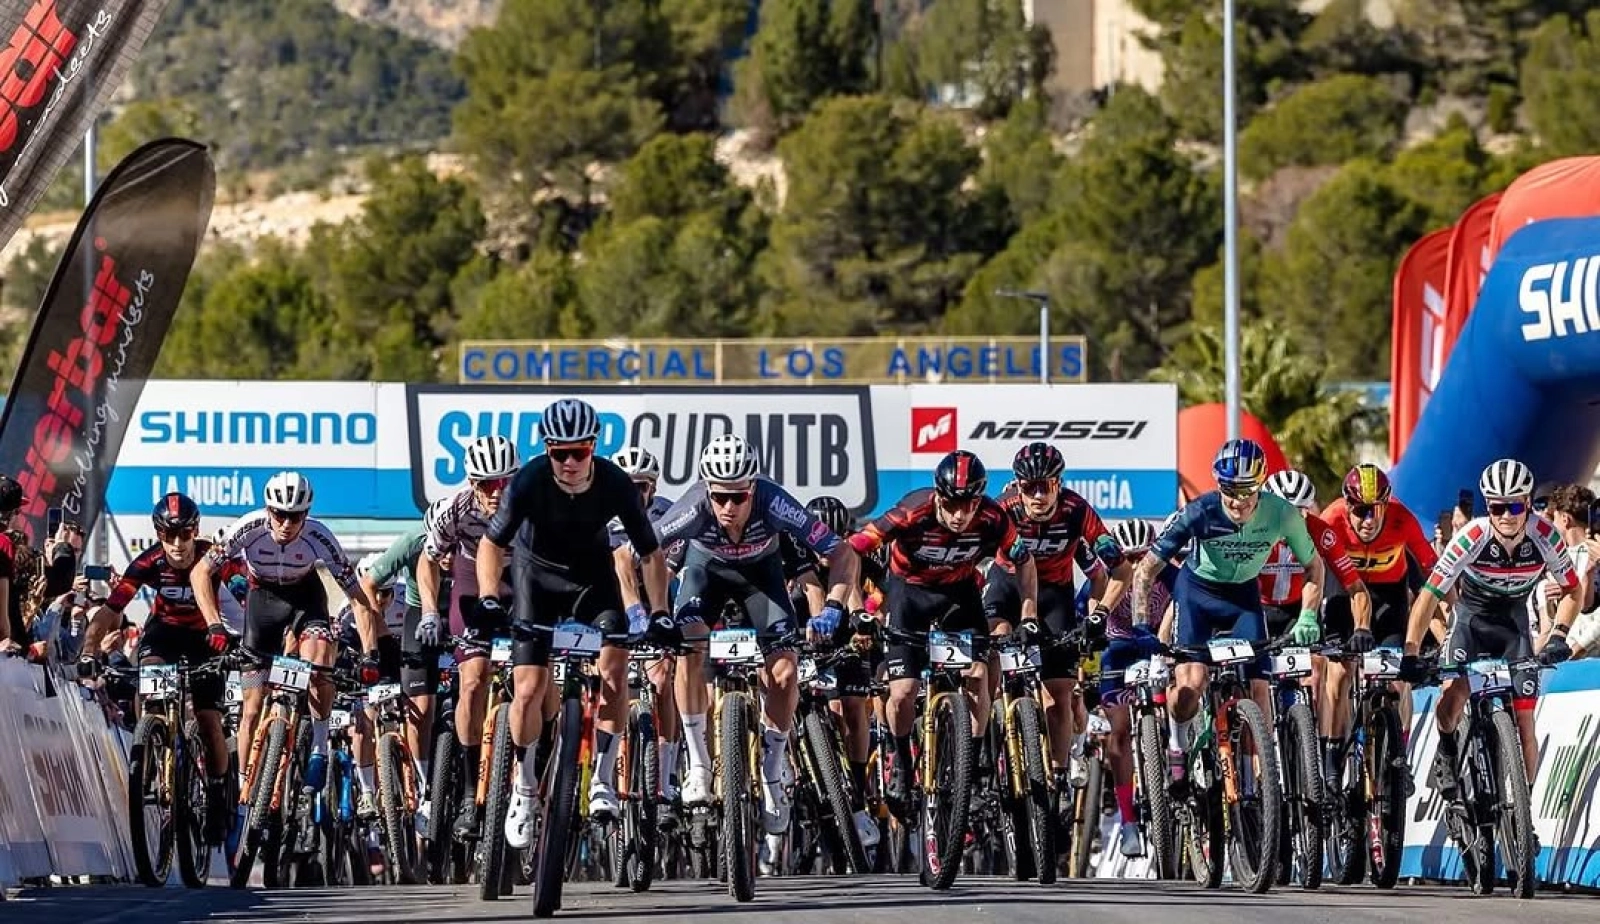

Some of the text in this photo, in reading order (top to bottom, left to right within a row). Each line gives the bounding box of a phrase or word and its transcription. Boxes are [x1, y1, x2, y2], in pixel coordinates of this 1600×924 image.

[107, 269, 154, 393] mindsets
[463, 346, 1084, 380] COMERCIAL LOS ANGELES
[140, 410, 377, 445] SHIMANO
[187, 469, 256, 507] NUCÍA
[768, 494, 808, 529] Alpecin
[914, 545, 980, 562] BH
[573, 633, 583, 648] 7
[728, 643, 739, 657] 4
[946, 647, 955, 662] 2
[1228, 645, 1236, 656] 1
[1011, 652, 1029, 668] 12
[1286, 655, 1296, 672] 9
[1380, 658, 1389, 672] 5
[282, 670, 299, 686] 11
[1135, 666, 1149, 679] 23
[1481, 672, 1499, 687] 21
